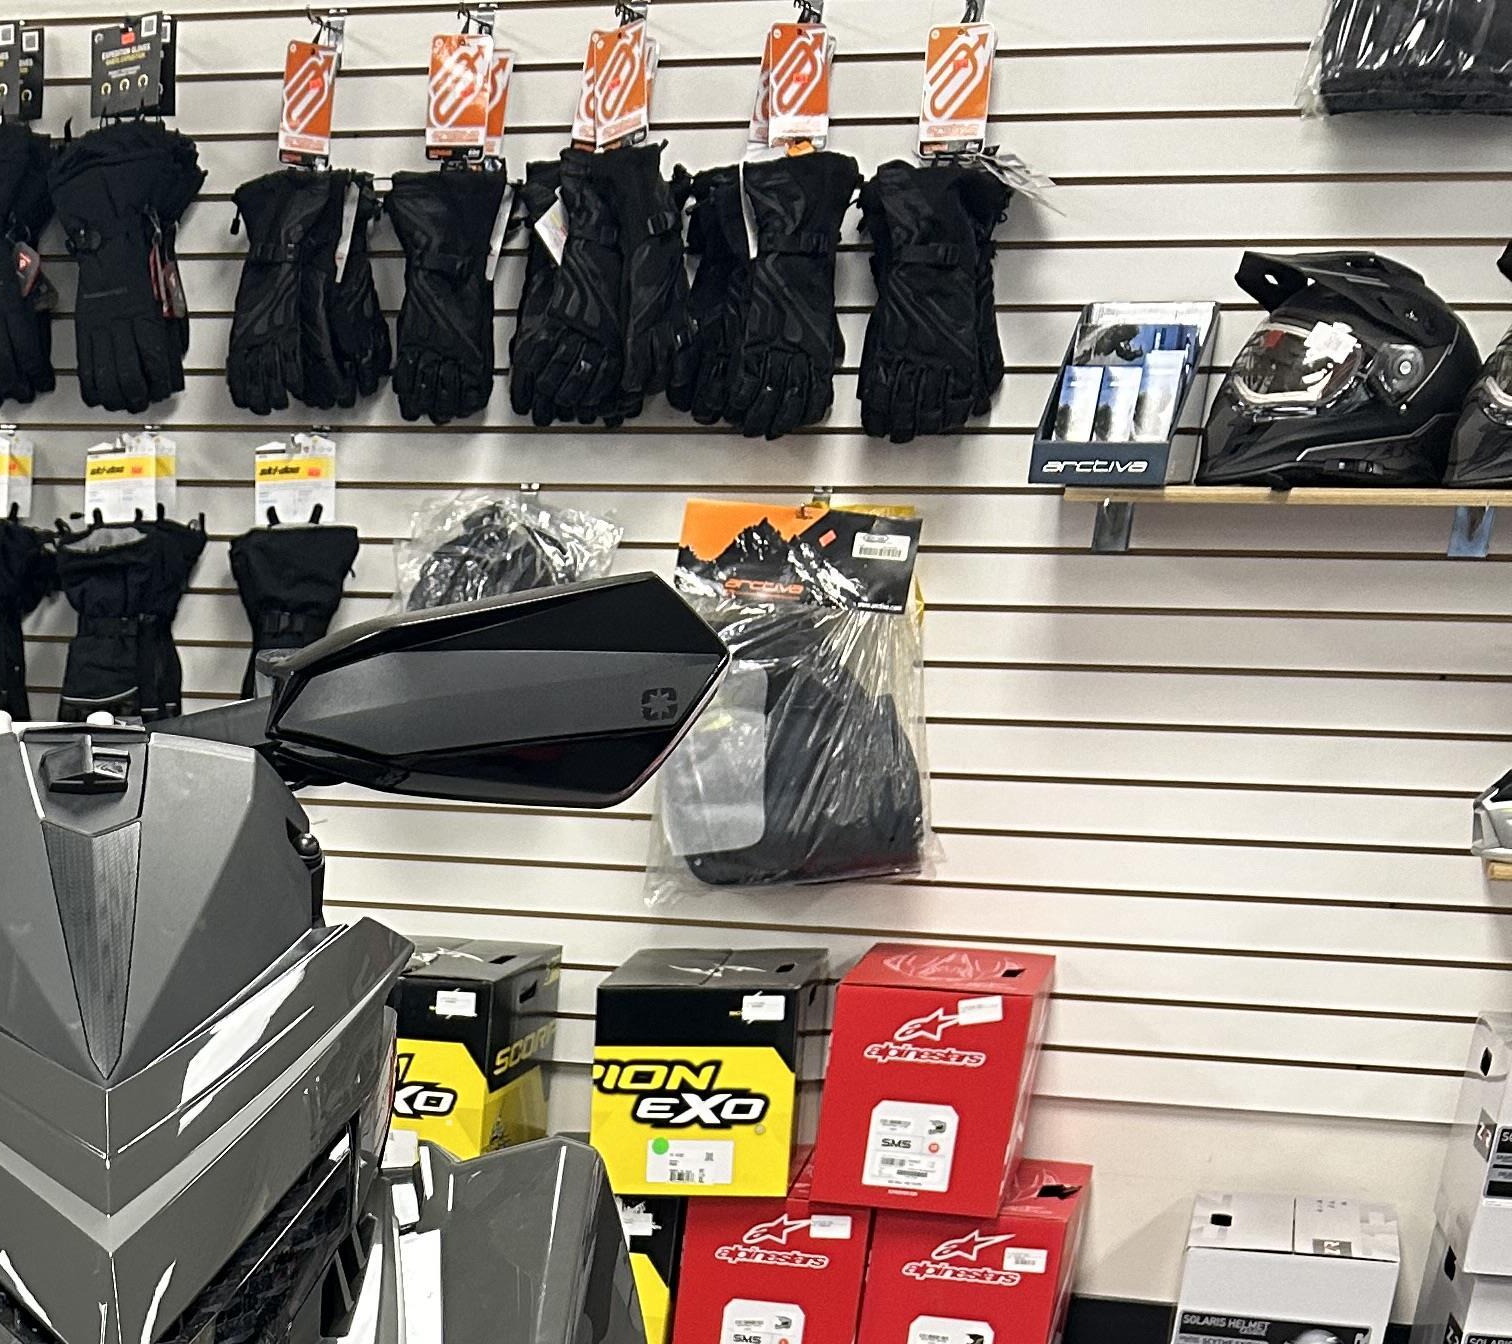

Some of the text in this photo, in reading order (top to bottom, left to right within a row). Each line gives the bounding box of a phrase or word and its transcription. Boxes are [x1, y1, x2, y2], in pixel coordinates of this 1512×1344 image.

[1042, 458, 1149, 474] arctiva
[723, 577, 806, 595] arctiva
[863, 1041, 987, 1068] alpinestars
[714, 1244, 830, 1270] alpinestars
[901, 1260, 1021, 1287] alpinestars
[1183, 1314, 1227, 1328] SOLARIS
[1228, 1317, 1271, 1333] HELMET
